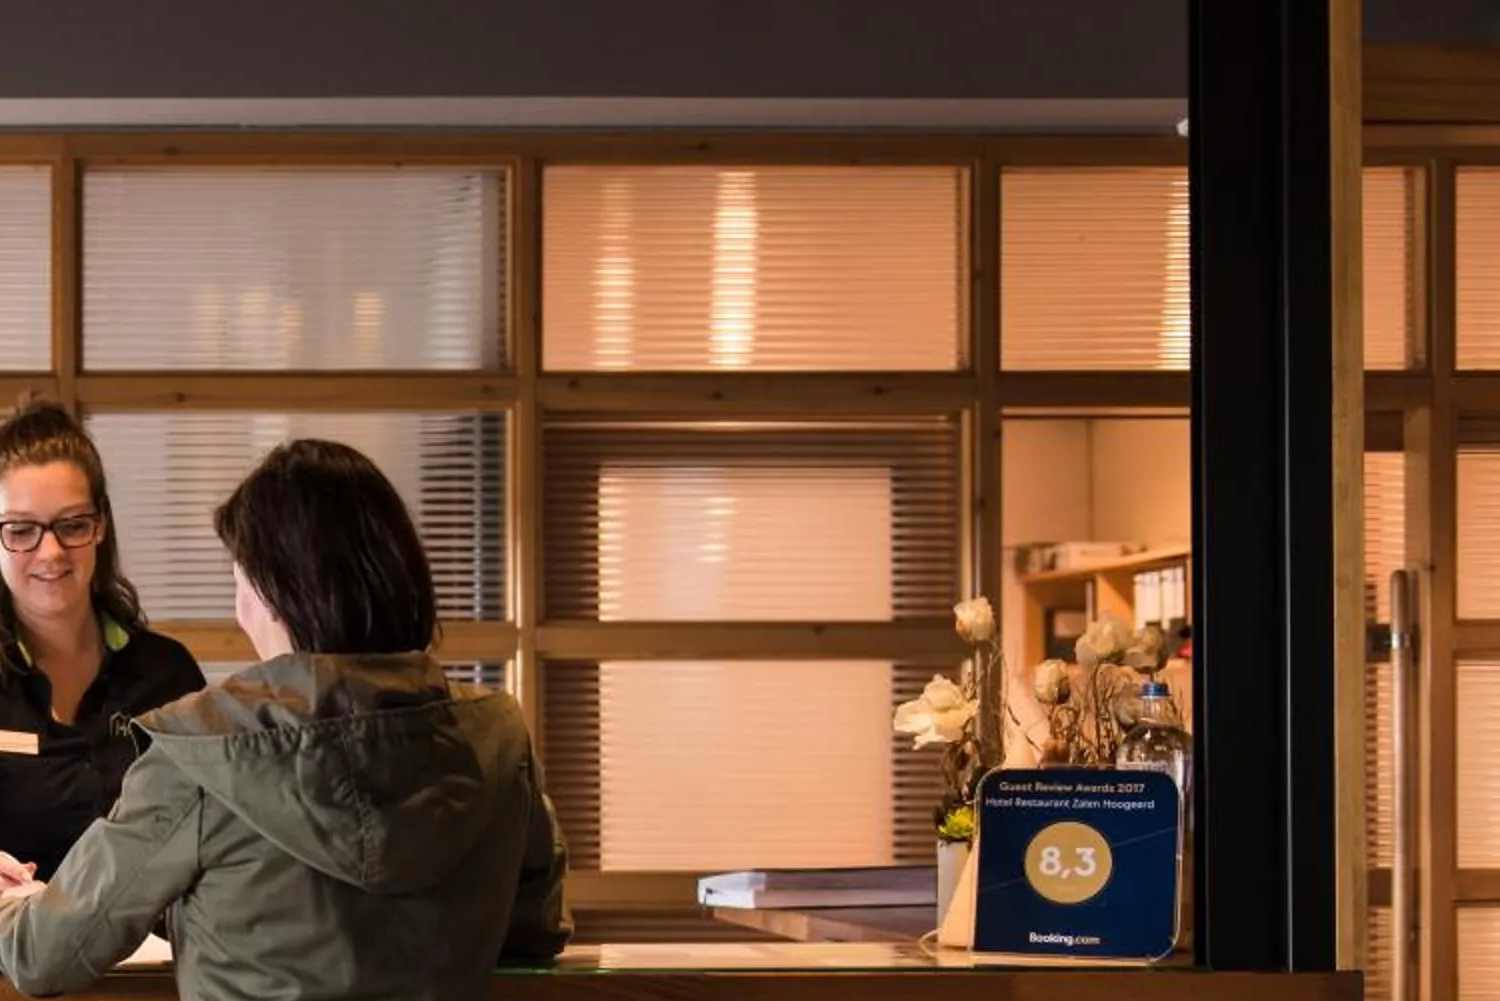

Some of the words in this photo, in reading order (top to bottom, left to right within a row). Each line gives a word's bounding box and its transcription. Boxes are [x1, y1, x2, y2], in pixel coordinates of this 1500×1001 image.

[1000, 781, 1032, 793] Guest
[1035, 781, 1073, 793] Review
[1075, 783, 1115, 793] Awards
[1116, 783, 1145, 793] 2017
[986, 798, 1013, 807] Hotel
[1015, 797, 1069, 808] Restaurant
[1038, 847, 1097, 879] 8,3
[1028, 931, 1101, 947] Booking.com
